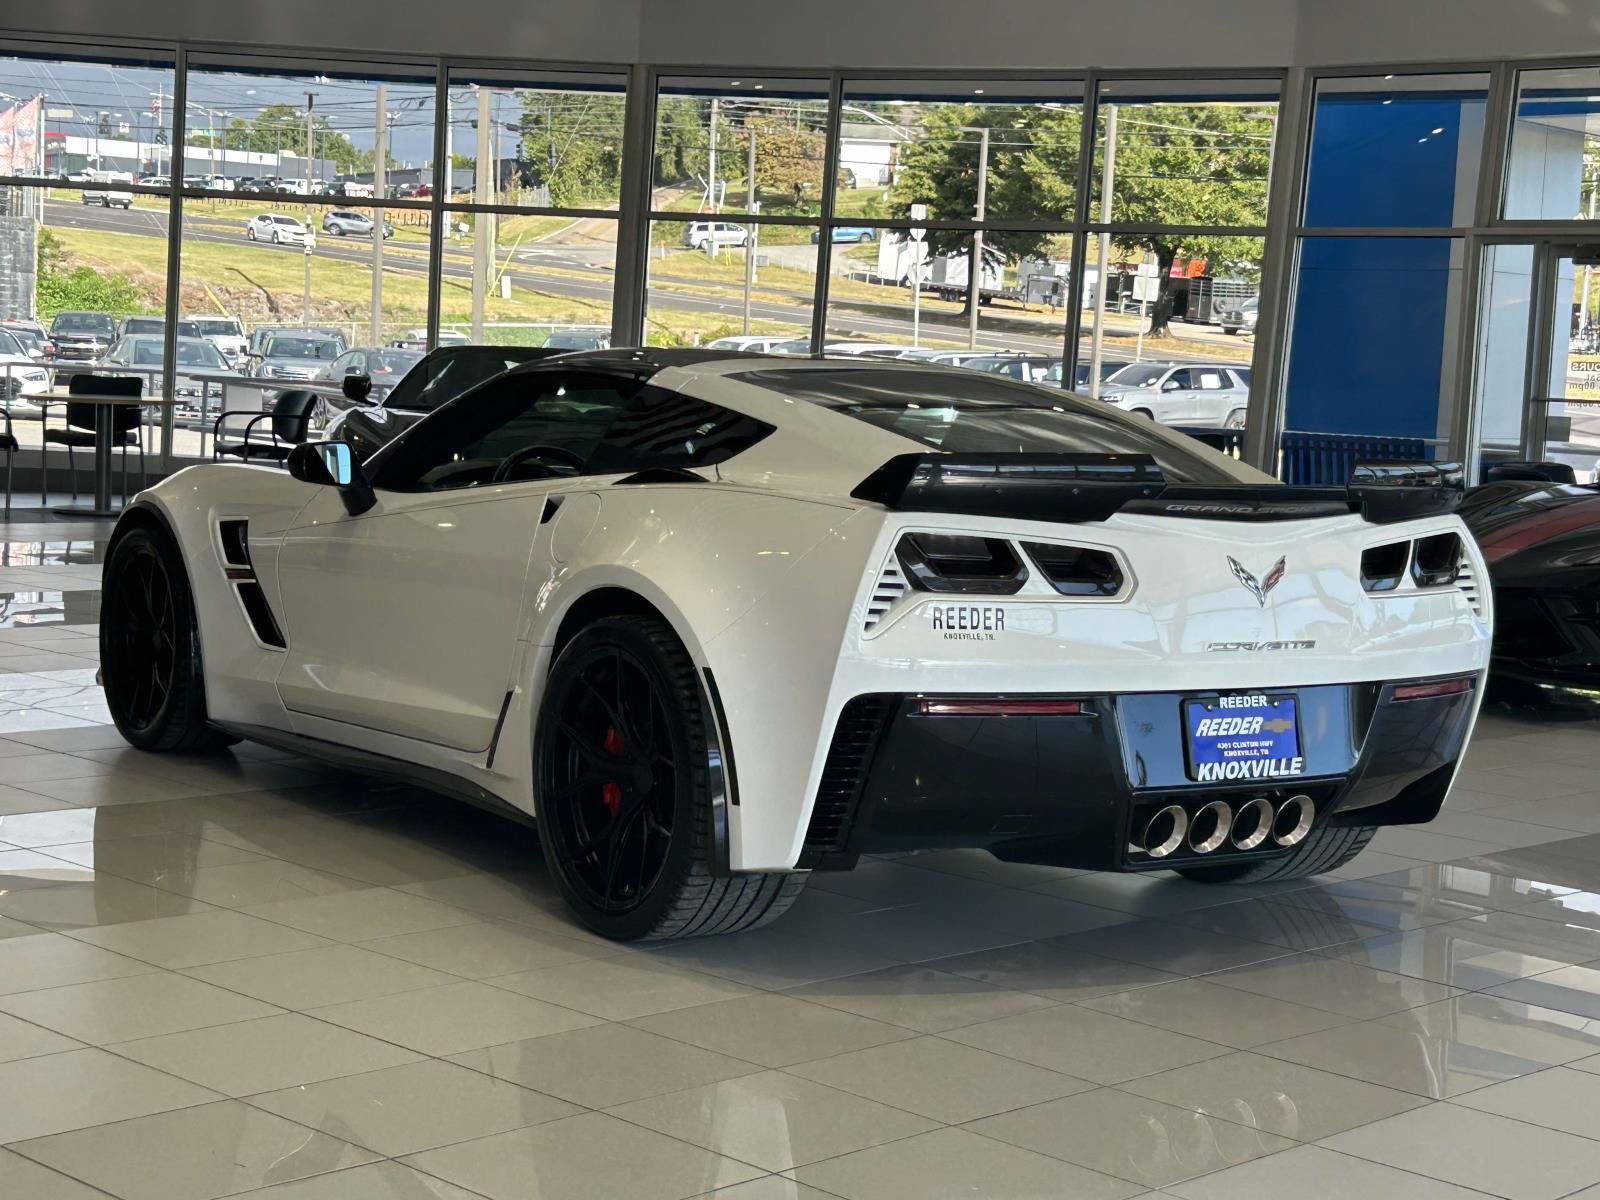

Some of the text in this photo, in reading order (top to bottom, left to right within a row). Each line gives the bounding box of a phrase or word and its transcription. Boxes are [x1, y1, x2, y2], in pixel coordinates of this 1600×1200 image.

[1165, 504, 1254, 513] GRAND
[933, 606, 1005, 631] REEDER
[1207, 640, 1316, 652] CORVETTE
[1219, 695, 1268, 709] REEDER
[1195, 716, 1264, 737] REEDER
[1197, 757, 1302, 781] KNOXVILLE
